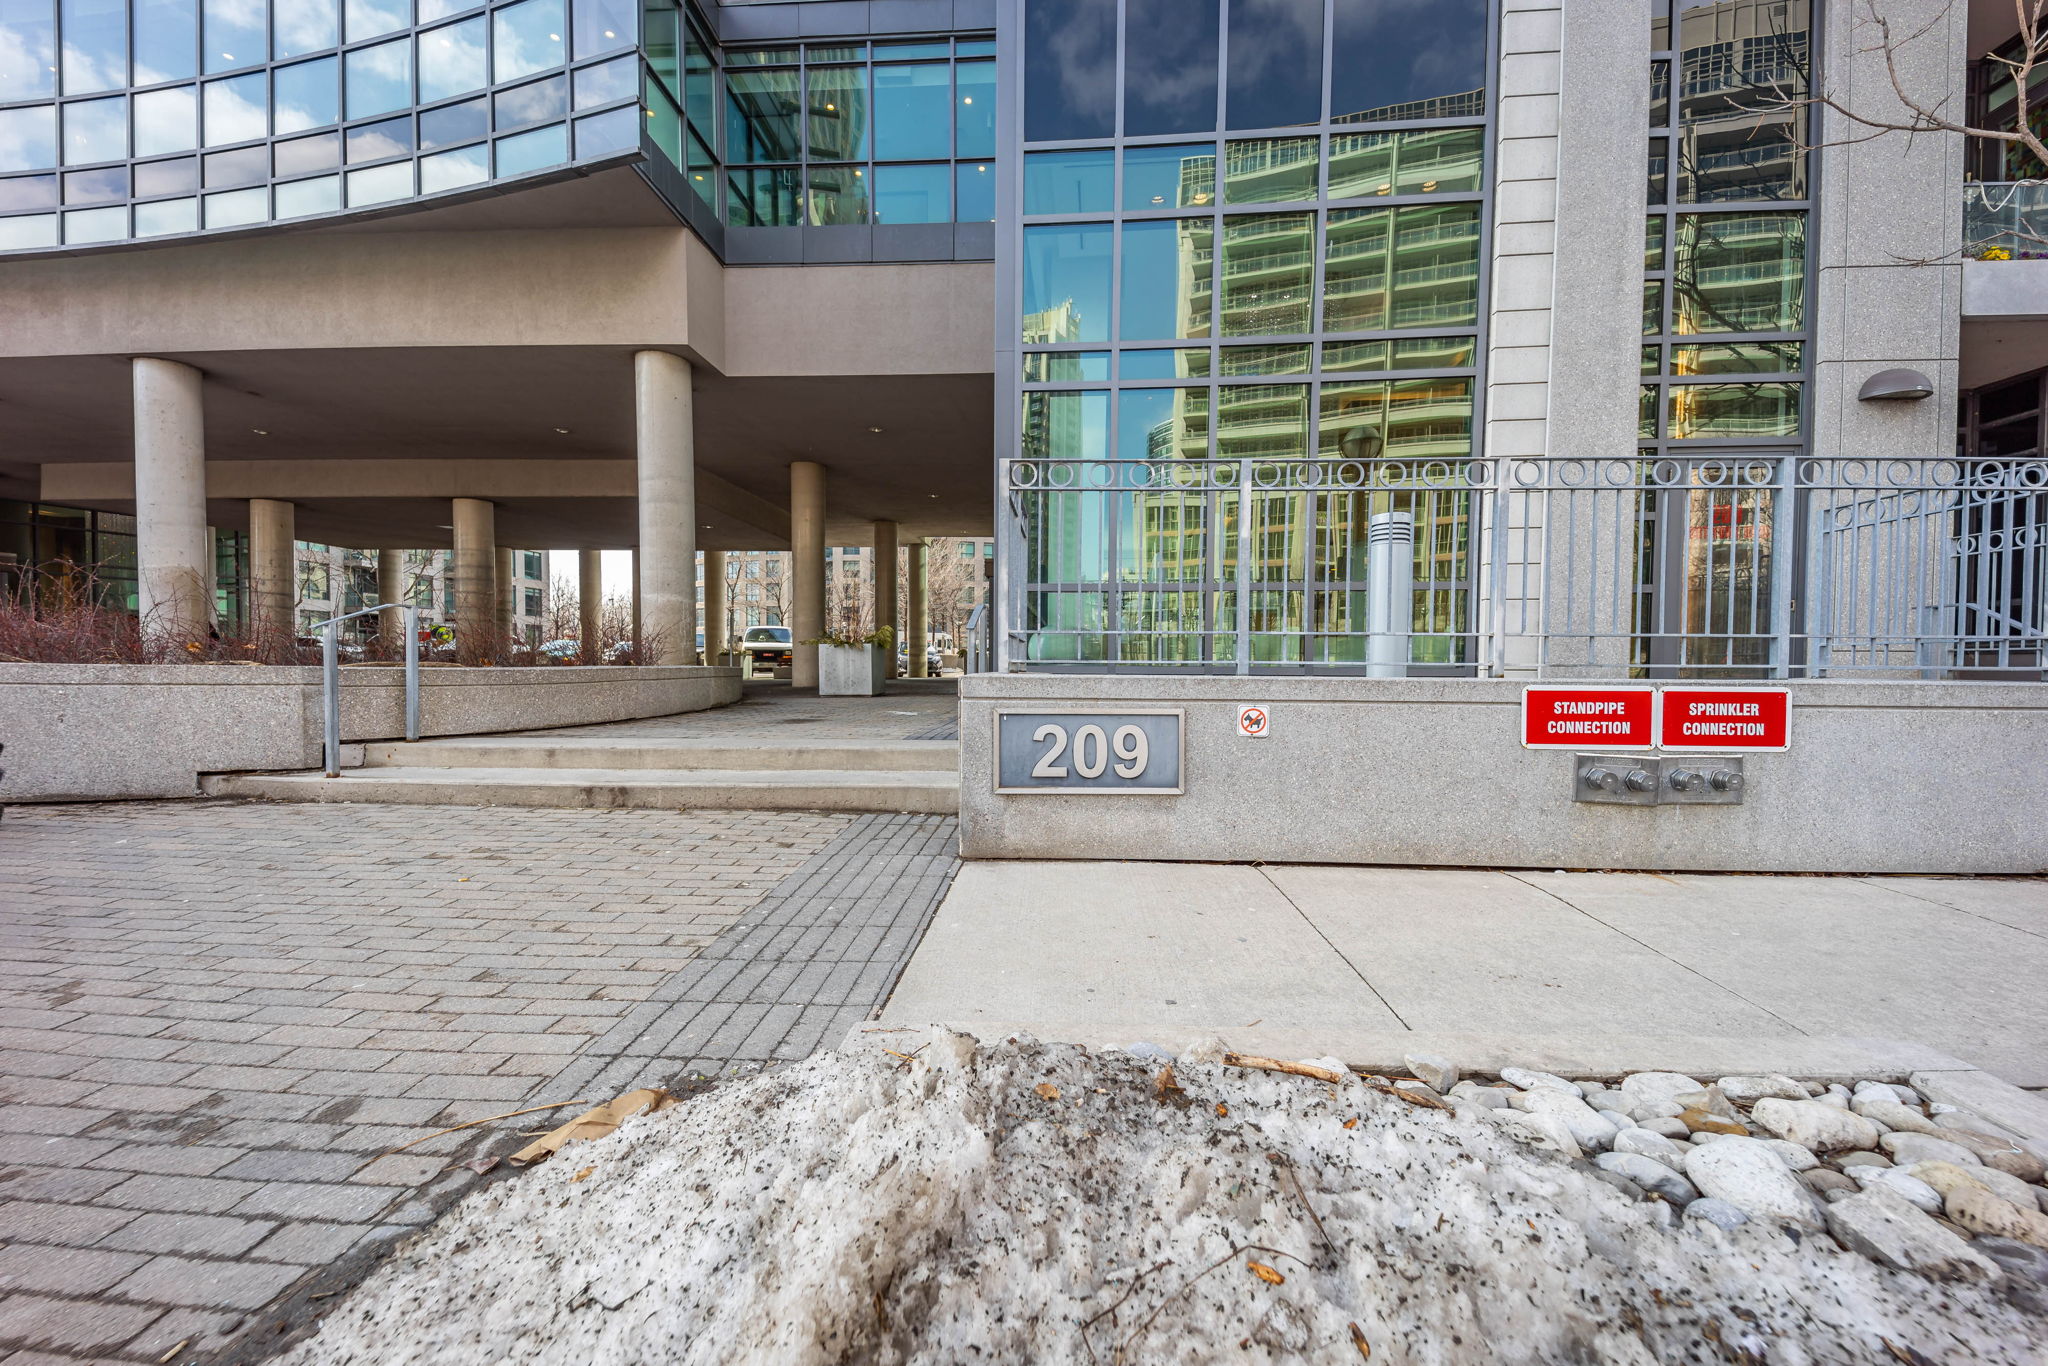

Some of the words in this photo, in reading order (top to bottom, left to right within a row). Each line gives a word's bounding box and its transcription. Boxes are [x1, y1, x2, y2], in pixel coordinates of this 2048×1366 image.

[1553, 701, 1625, 715] STANDPIPE
[1689, 702, 1760, 716] SPRINKLER
[1547, 720, 1631, 734] CONNECTION
[1682, 722, 1765, 736] CONNECTION
[1031, 723, 1149, 779] 209
